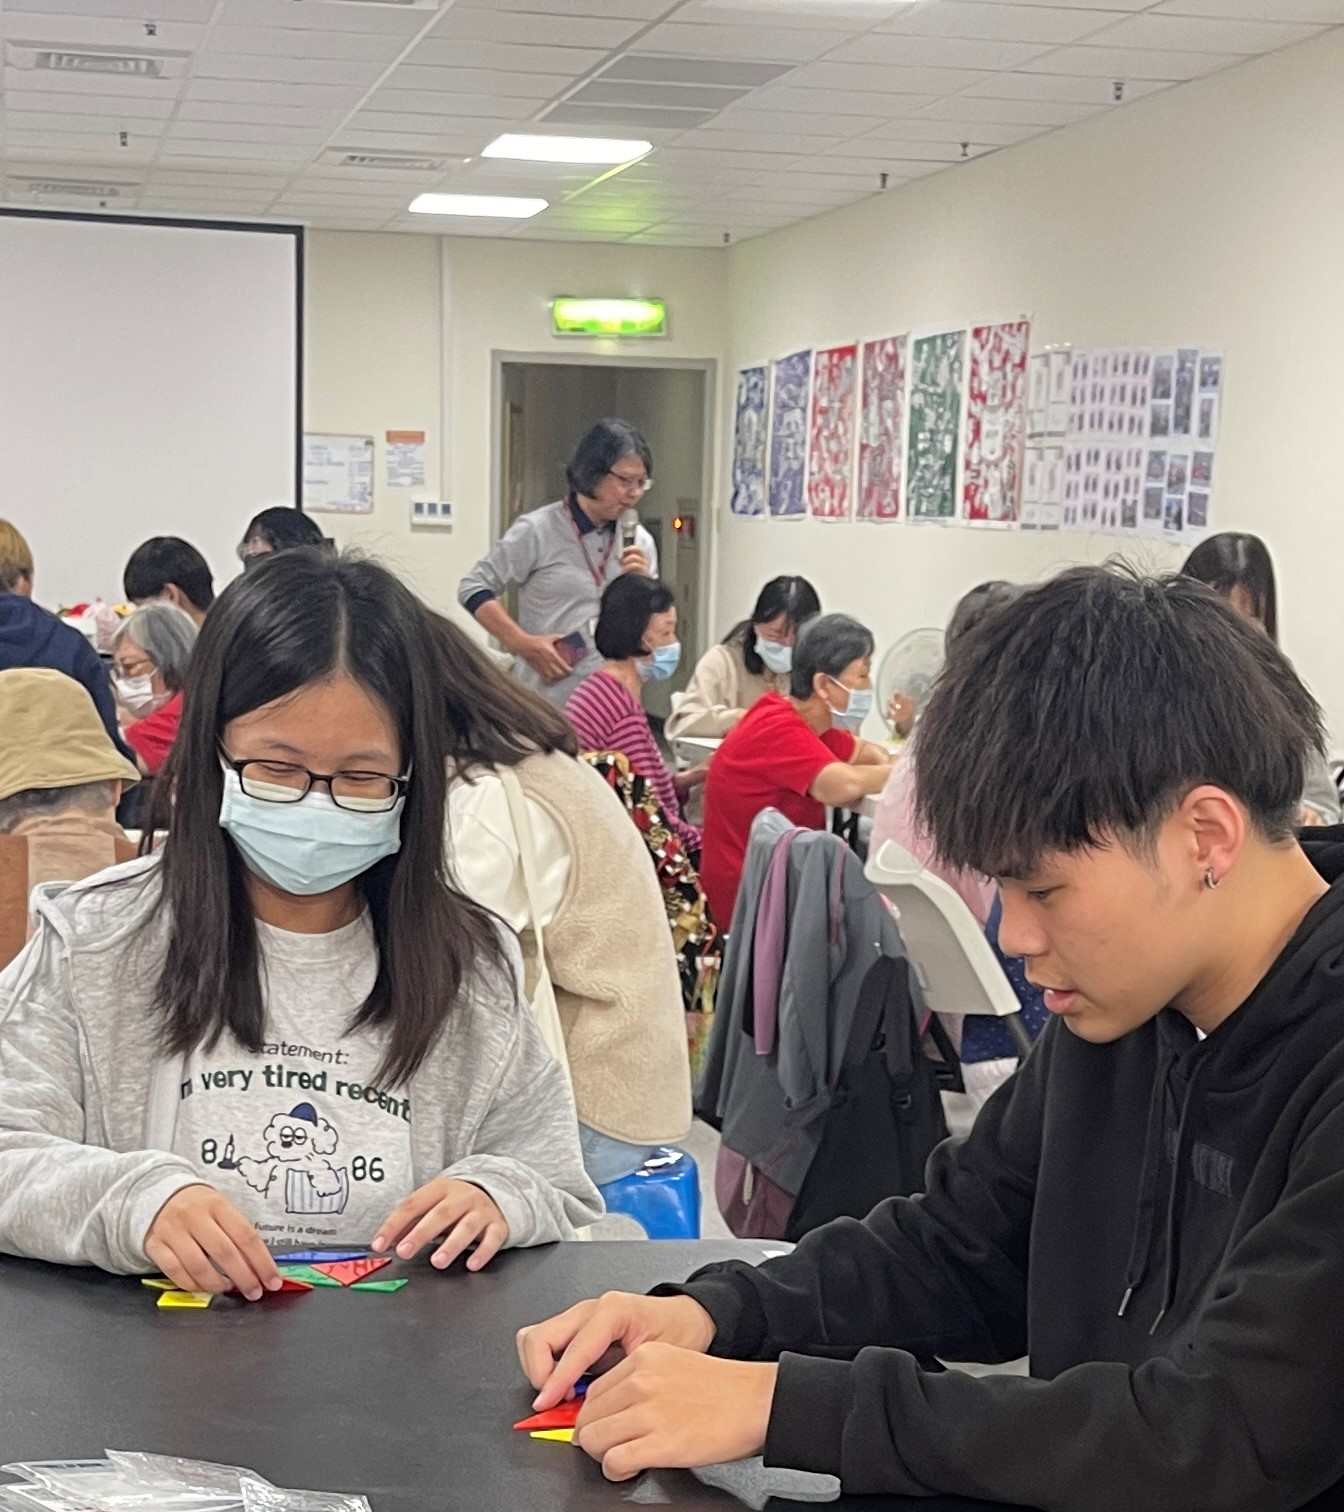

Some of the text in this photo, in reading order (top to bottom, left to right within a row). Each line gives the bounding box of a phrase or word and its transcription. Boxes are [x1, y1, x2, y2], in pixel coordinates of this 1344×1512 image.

[201, 1069, 253, 1091] very
[262, 1064, 327, 1090] tired
[352, 1155, 385, 1182] 86
